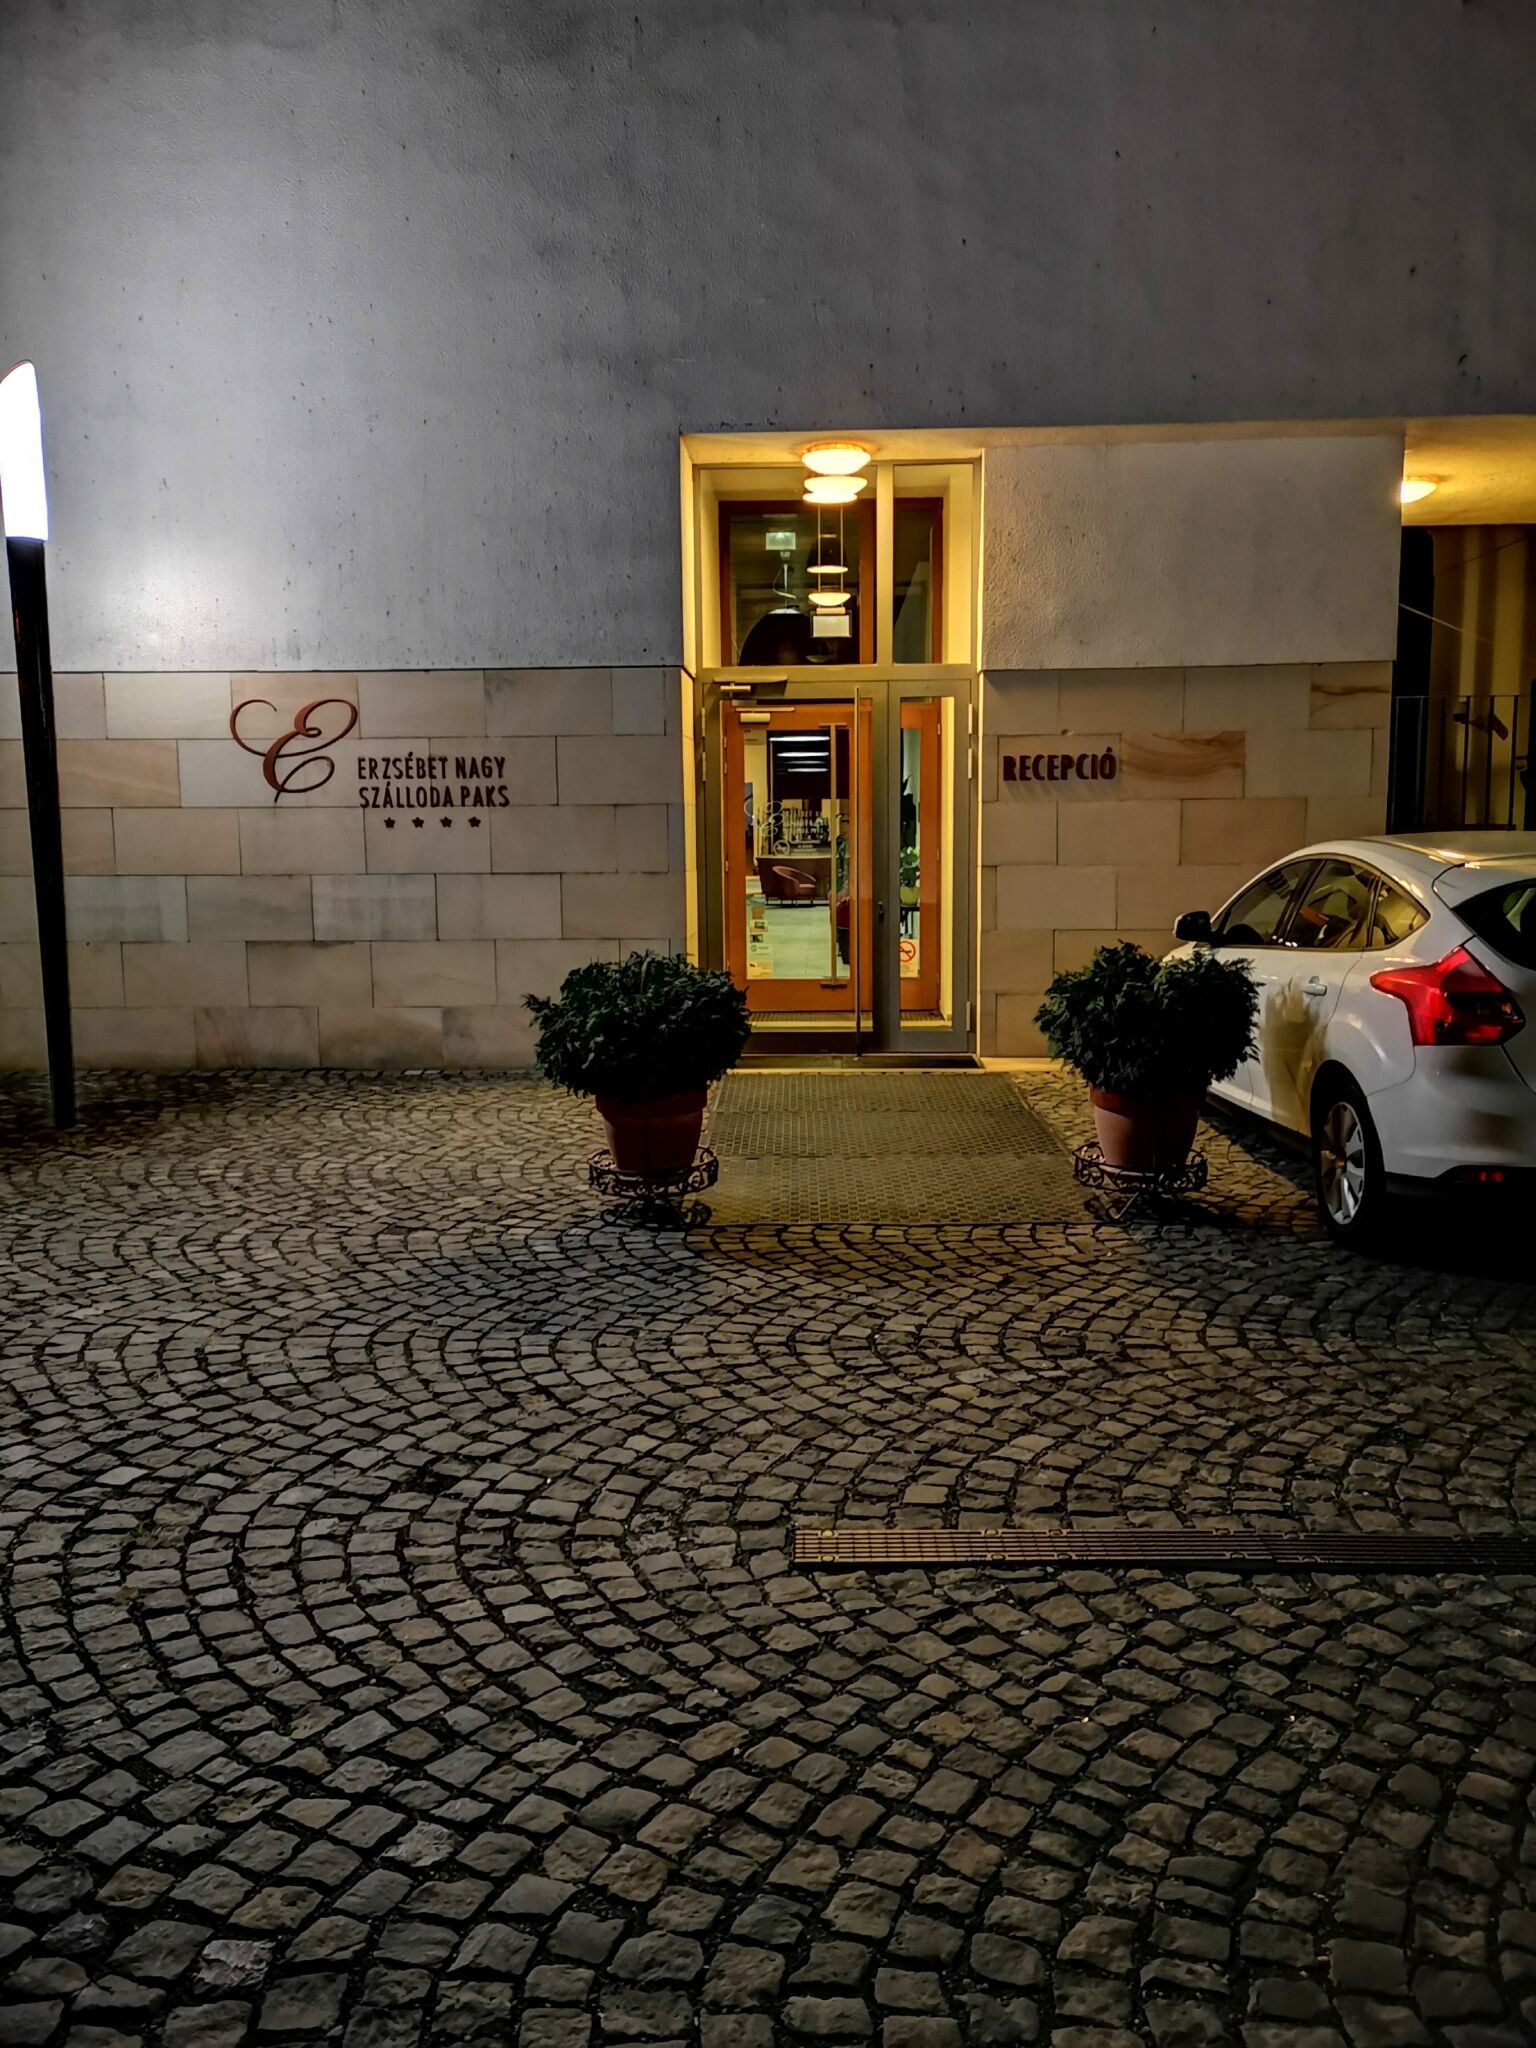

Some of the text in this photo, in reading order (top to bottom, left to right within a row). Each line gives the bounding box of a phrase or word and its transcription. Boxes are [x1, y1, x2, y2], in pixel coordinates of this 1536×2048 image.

[357, 752, 506, 780] ERZSÉBET NAGY
[1003, 746, 1117, 781] RECEPCIÓ
[359, 782, 510, 808] SZÁLLODA PAKS
